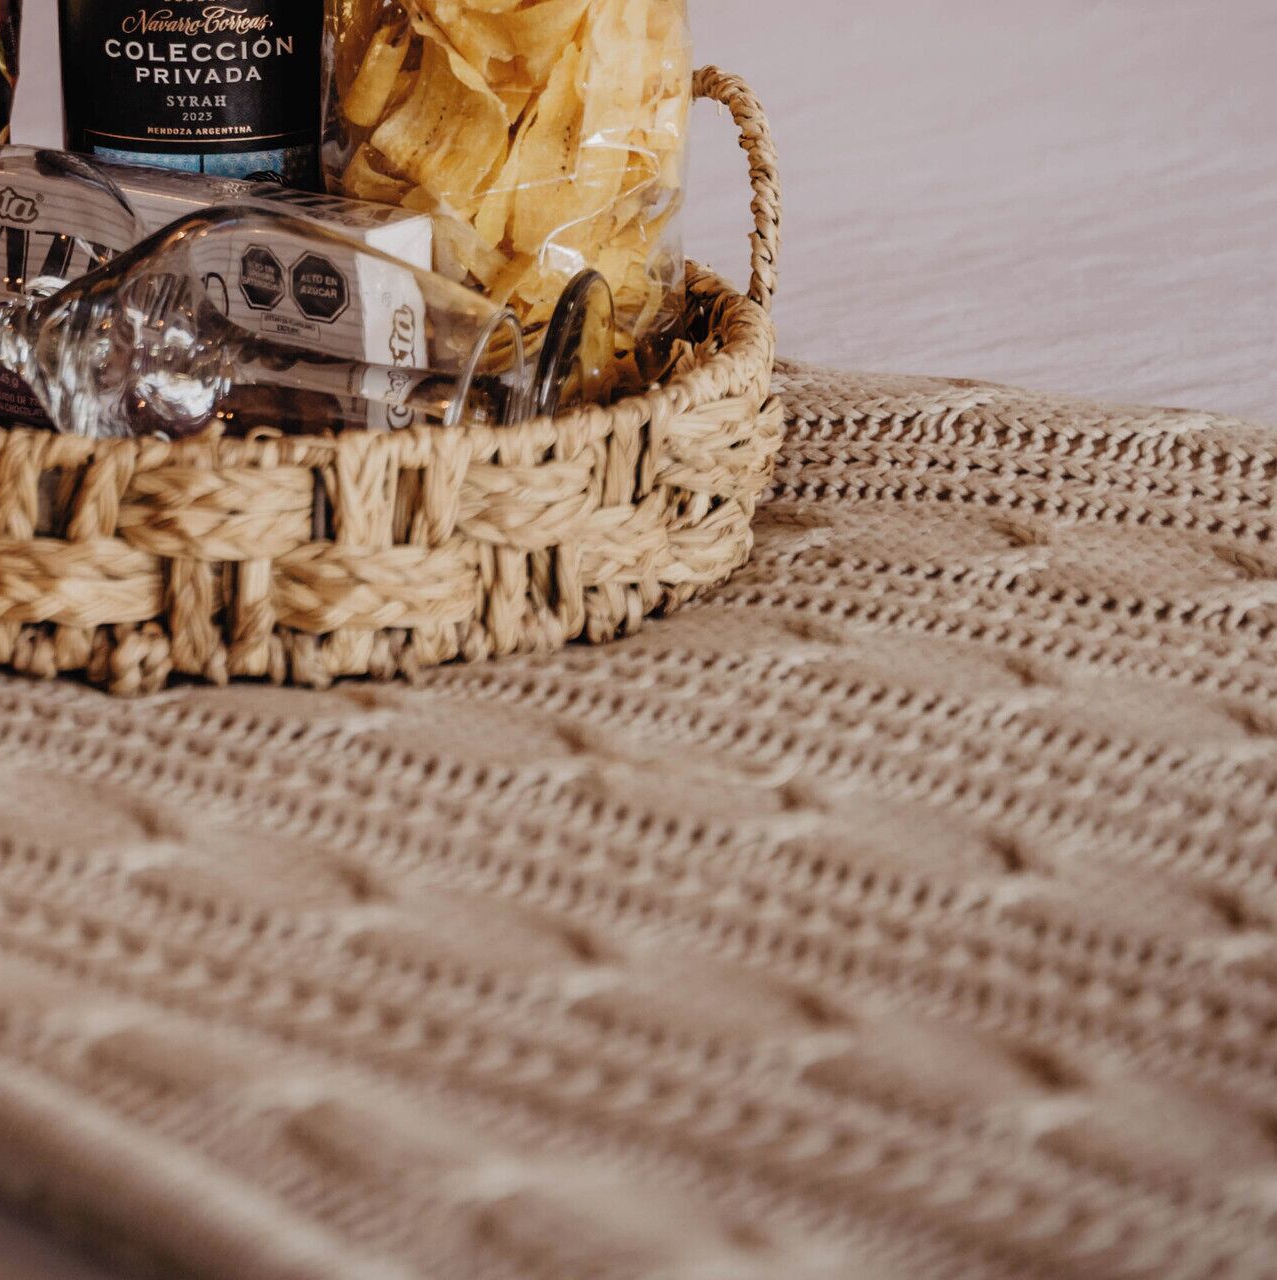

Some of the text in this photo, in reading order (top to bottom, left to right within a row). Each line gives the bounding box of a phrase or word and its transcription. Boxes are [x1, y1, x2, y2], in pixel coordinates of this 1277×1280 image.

[121, 5, 273, 36] Navarro Correas
[104, 35, 294, 63] COLECCIÓN
[135, 65, 263, 85] PRIVADA
[165, 94, 227, 108] SYRAH
[182, 111, 213, 122] 2023
[146, 124, 253, 135] MENDOZA ARGENTINA
